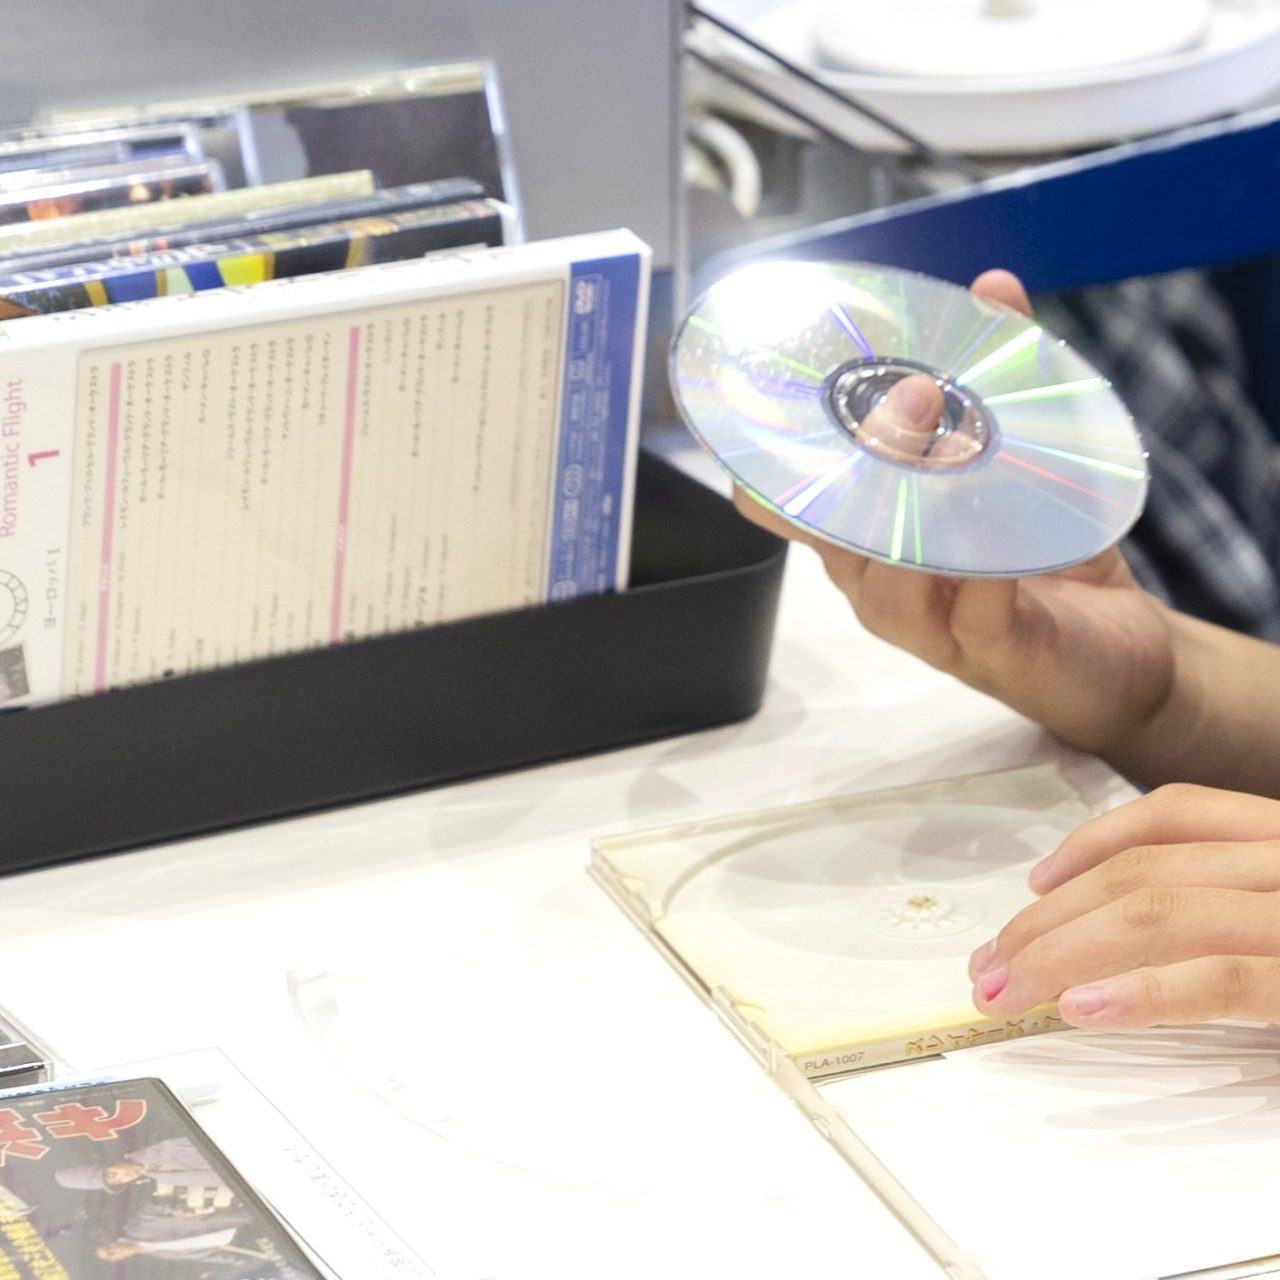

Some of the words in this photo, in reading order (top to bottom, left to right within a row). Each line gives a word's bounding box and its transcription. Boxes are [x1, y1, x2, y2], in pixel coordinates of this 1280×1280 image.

[2, 379, 27, 436] Flight
[28, 450, 60, 467] 1
[0, 443, 20, 537] Romantic
[804, 1052, 866, 1071] PLA-1007
